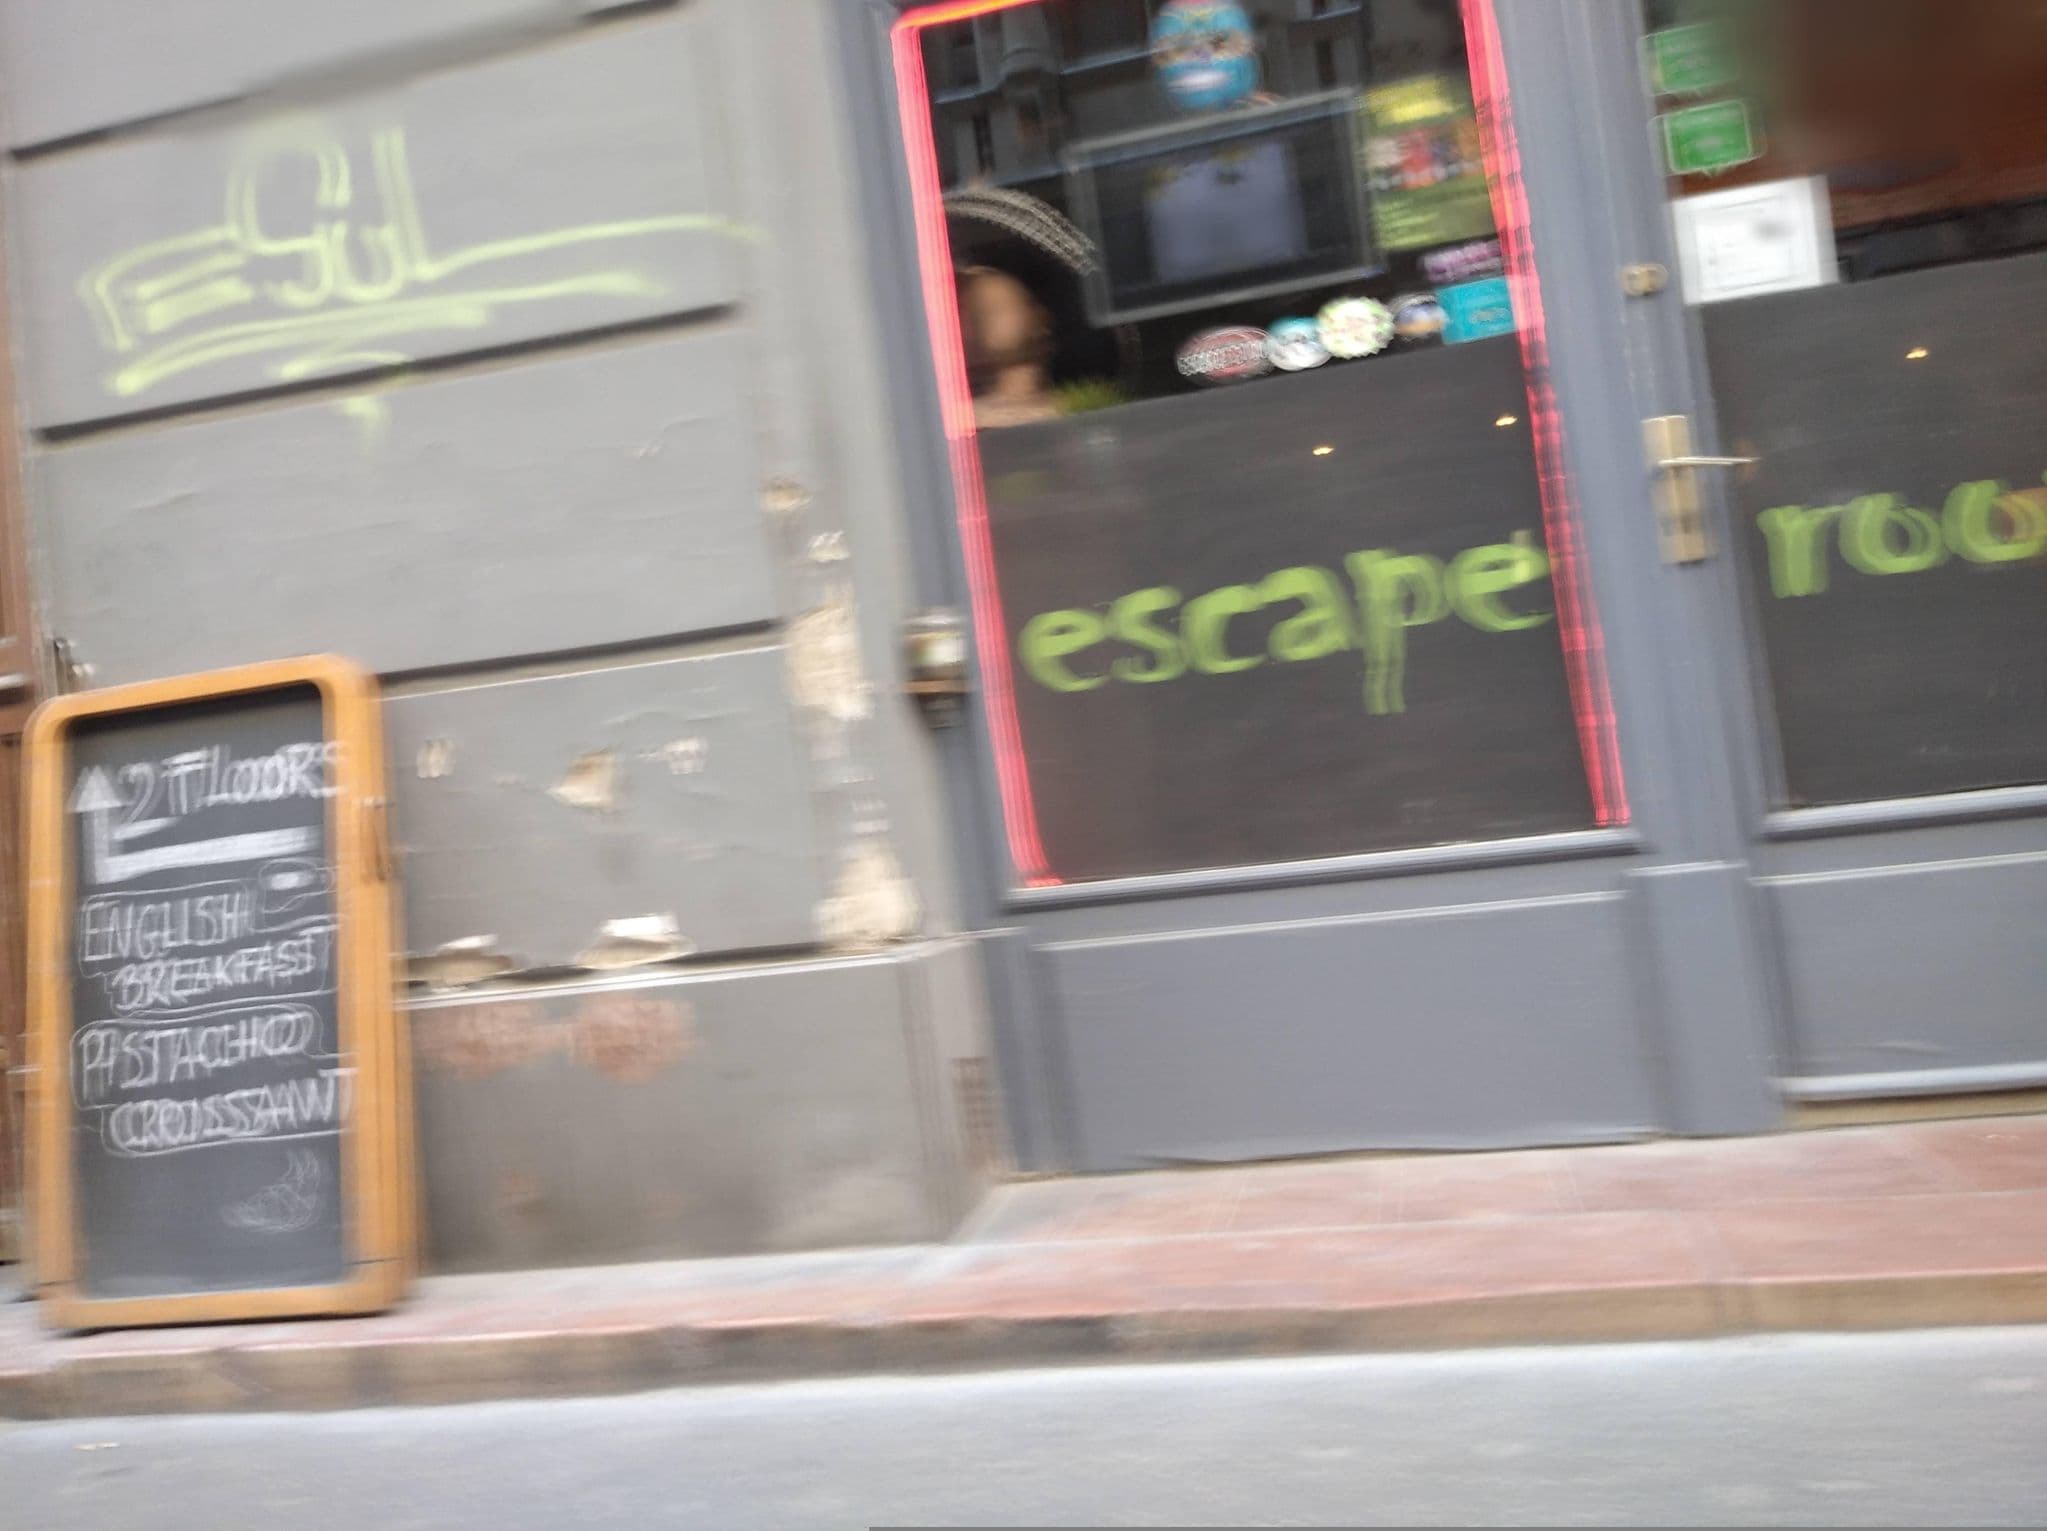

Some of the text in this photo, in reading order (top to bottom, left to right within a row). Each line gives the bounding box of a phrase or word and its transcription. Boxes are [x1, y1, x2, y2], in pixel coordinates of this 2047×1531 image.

[1019, 472, 2047, 715] escape roo
[110, 761, 172, 838] 2
[81, 892, 255, 962] ENGLISH
